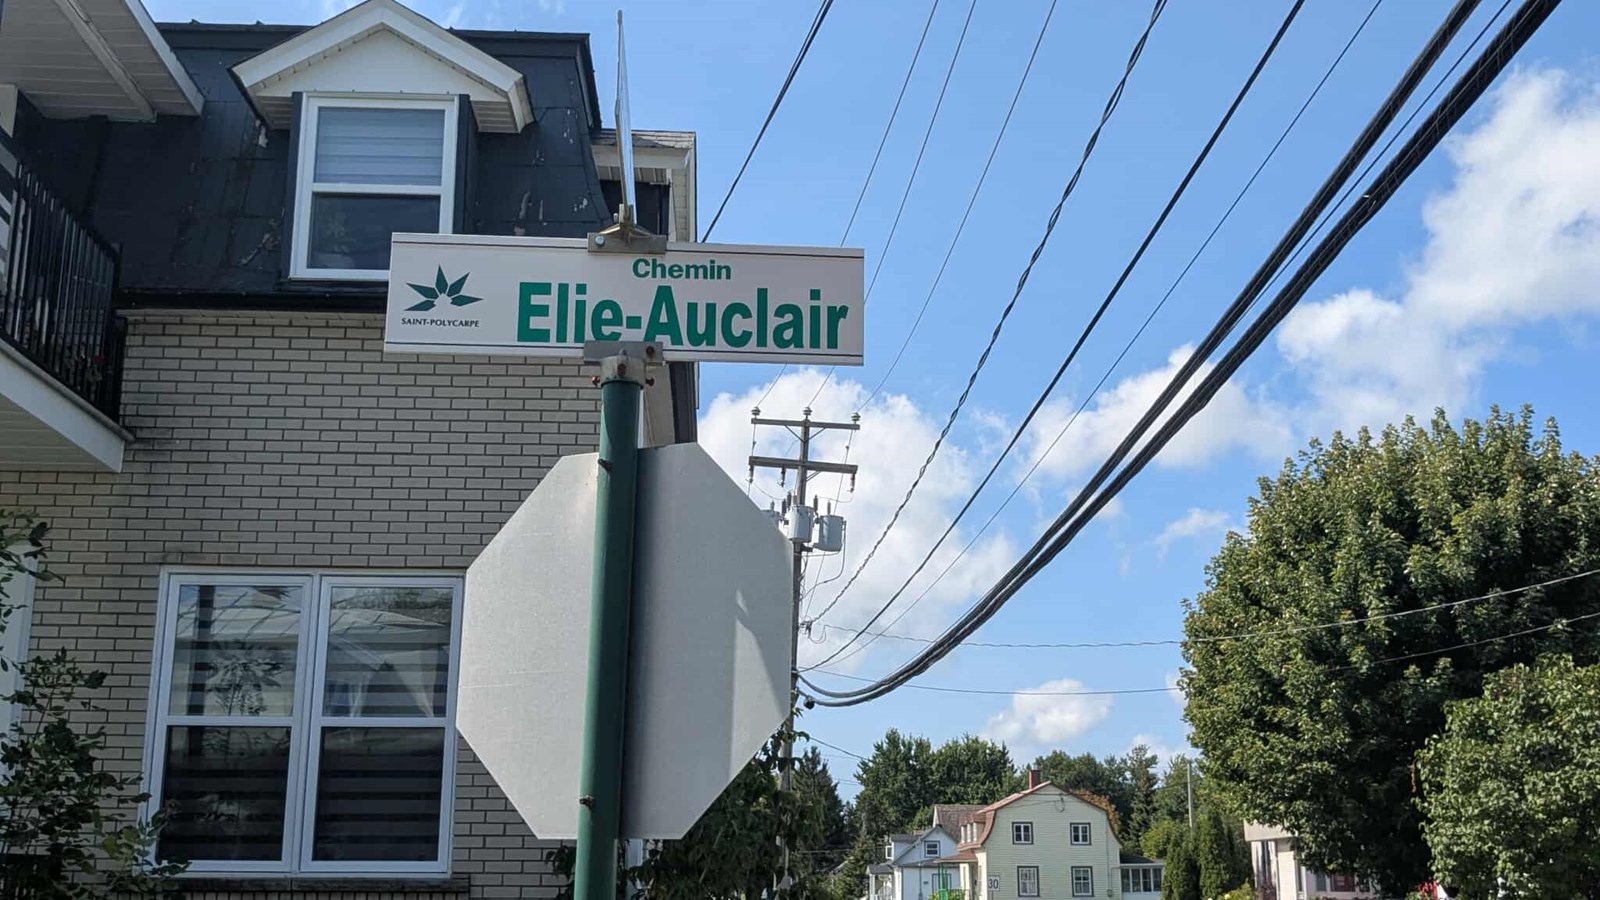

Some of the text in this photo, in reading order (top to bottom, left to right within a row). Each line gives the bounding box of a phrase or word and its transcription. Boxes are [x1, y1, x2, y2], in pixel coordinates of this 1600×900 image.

[632, 258, 732, 280] Chemin
[401, 317, 480, 328] SAINT-POLYCARPE
[516, 282, 848, 350] Elie-Auclair
[988, 878, 999, 889] 30
